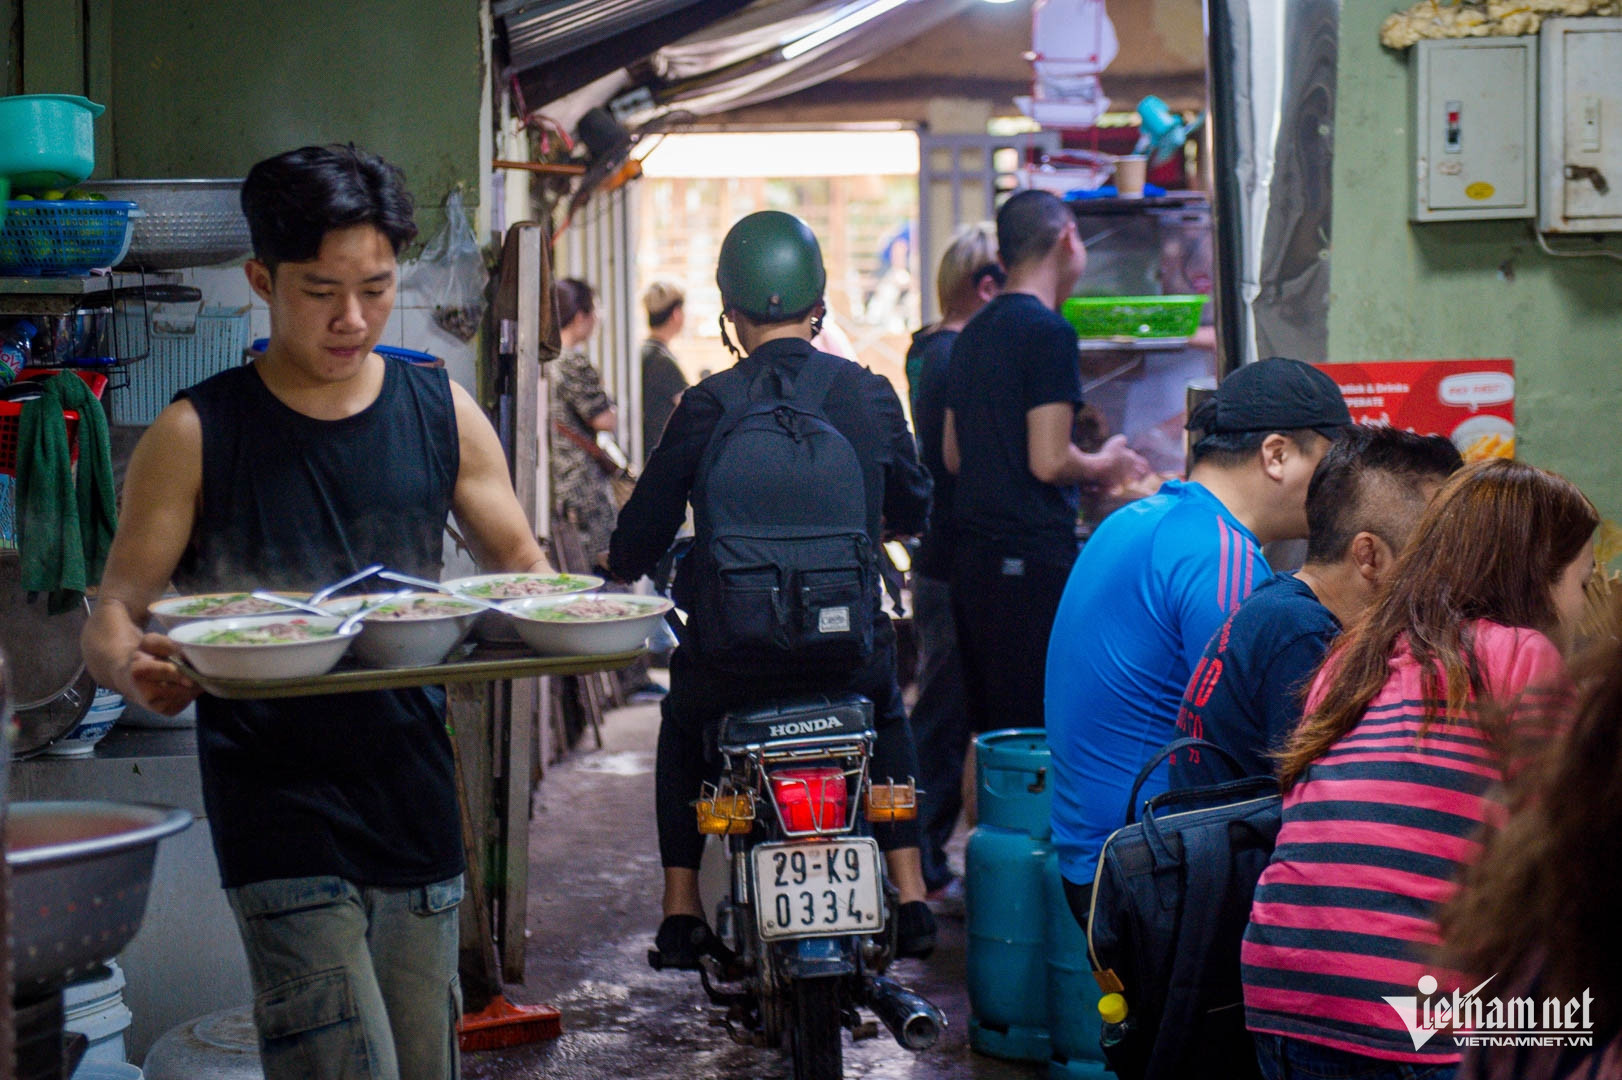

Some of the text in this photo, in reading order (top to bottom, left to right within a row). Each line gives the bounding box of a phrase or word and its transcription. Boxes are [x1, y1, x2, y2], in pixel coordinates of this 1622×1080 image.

[769, 716, 843, 737] HONDA
[772, 848, 860, 887] 29-K9
[775, 889, 862, 928] 0334
